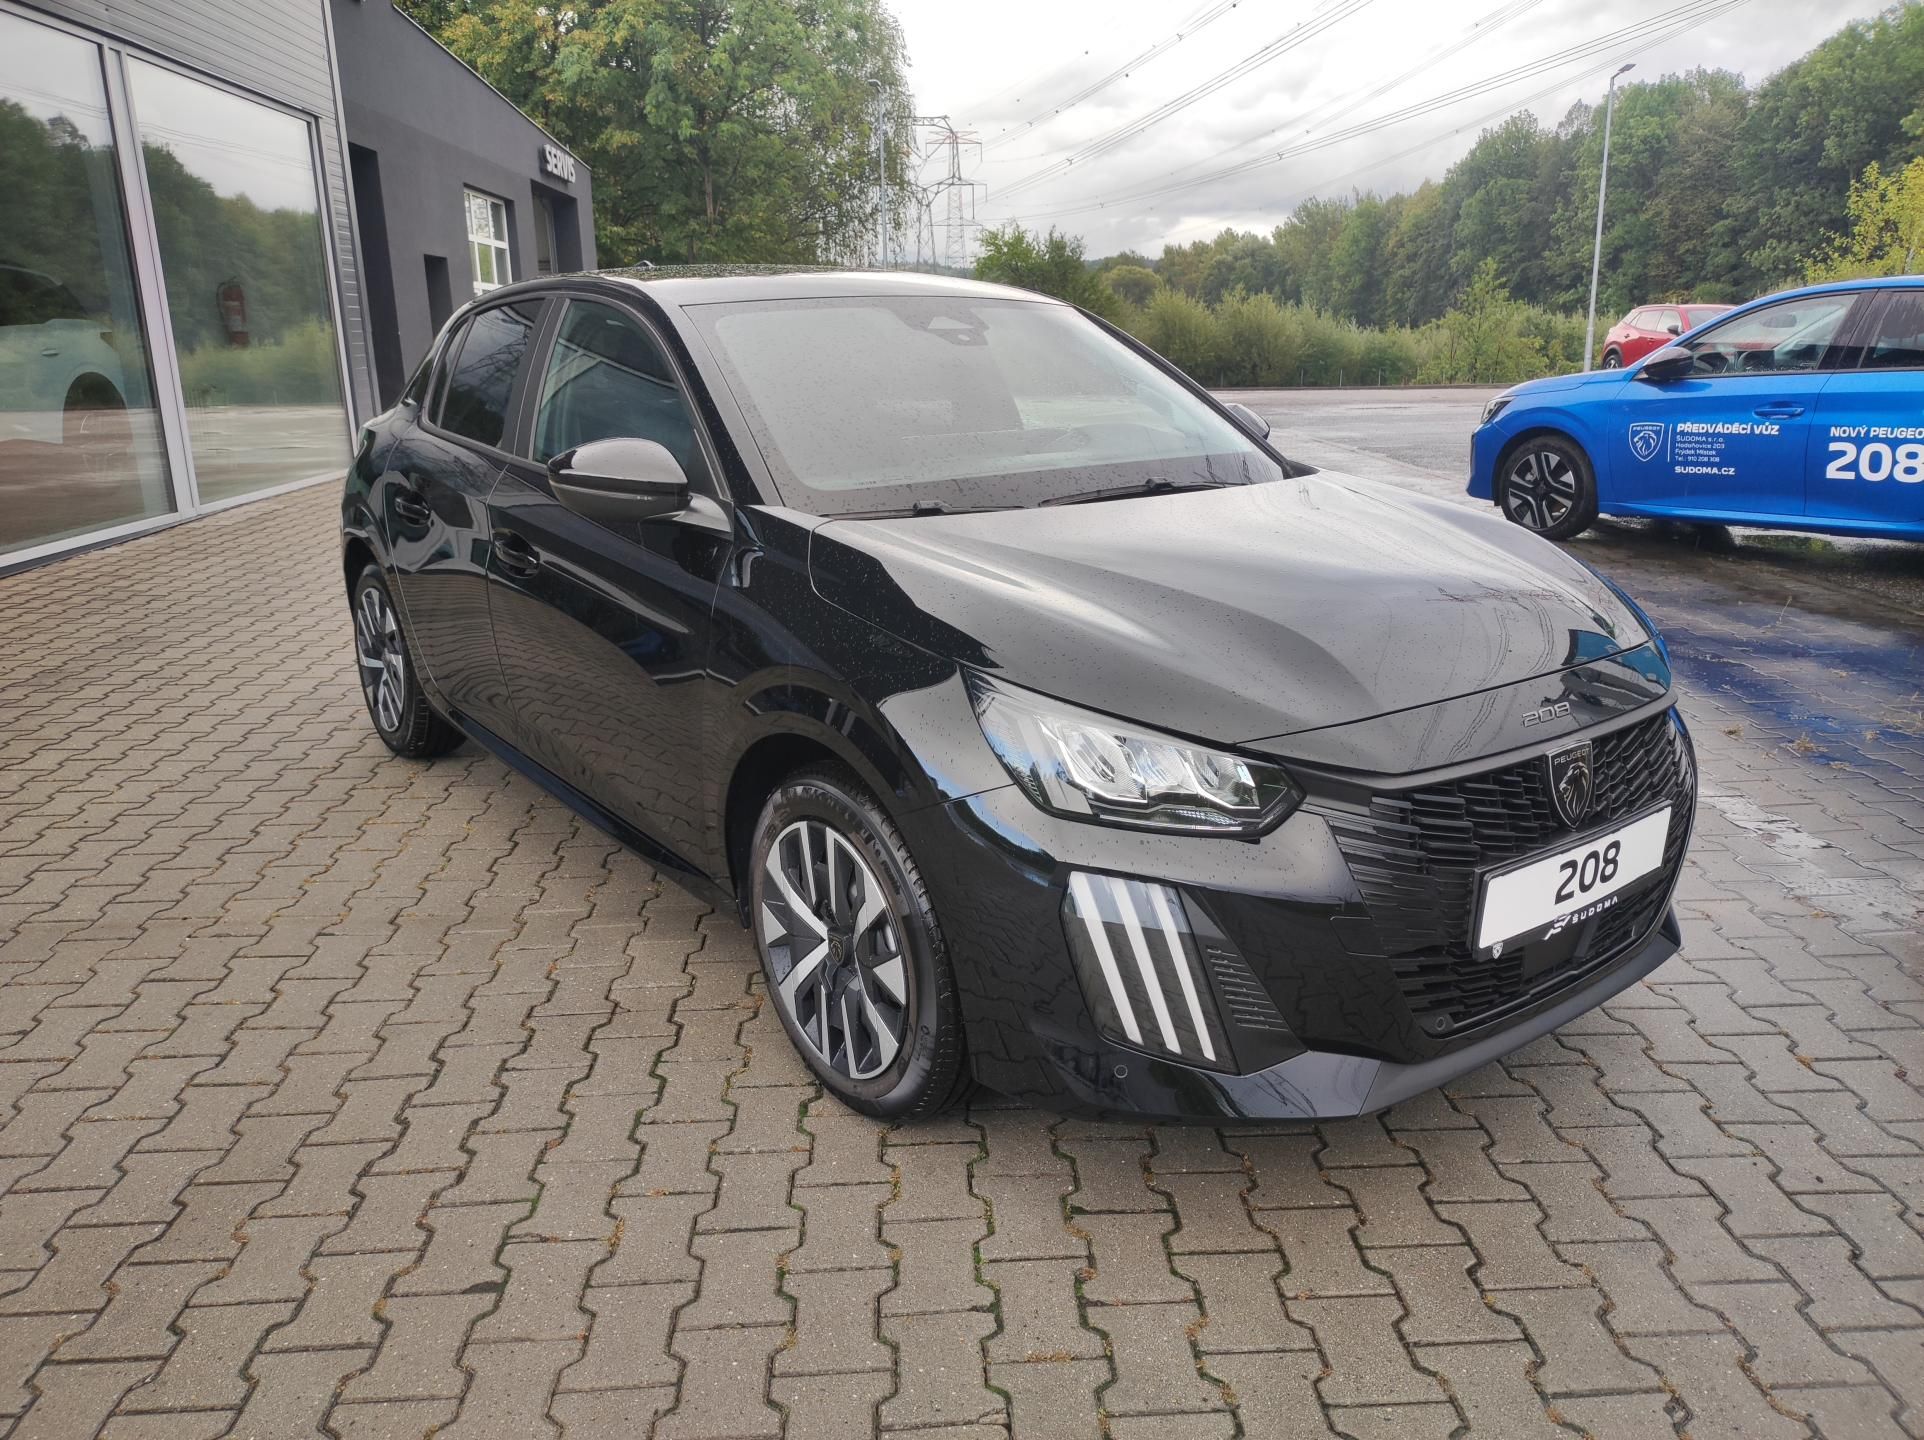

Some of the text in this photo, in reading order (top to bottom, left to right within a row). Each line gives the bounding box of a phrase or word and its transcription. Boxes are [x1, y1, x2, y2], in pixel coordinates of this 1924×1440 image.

[544, 144, 576, 184] SERVIS
[1676, 421, 1780, 435] PŘEDVÁDĚCÍ VŮZ
[1830, 424, 1868, 438] NOVÝ
[1674, 465, 1736, 475] SUDOMA.CZ
[1825, 441, 1924, 484] 208
[1521, 701, 1570, 728] 208
[1554, 747, 1590, 766] PEUGEOT
[1554, 840, 1621, 905] 208
[1572, 895, 1618, 923] SUDOMA
